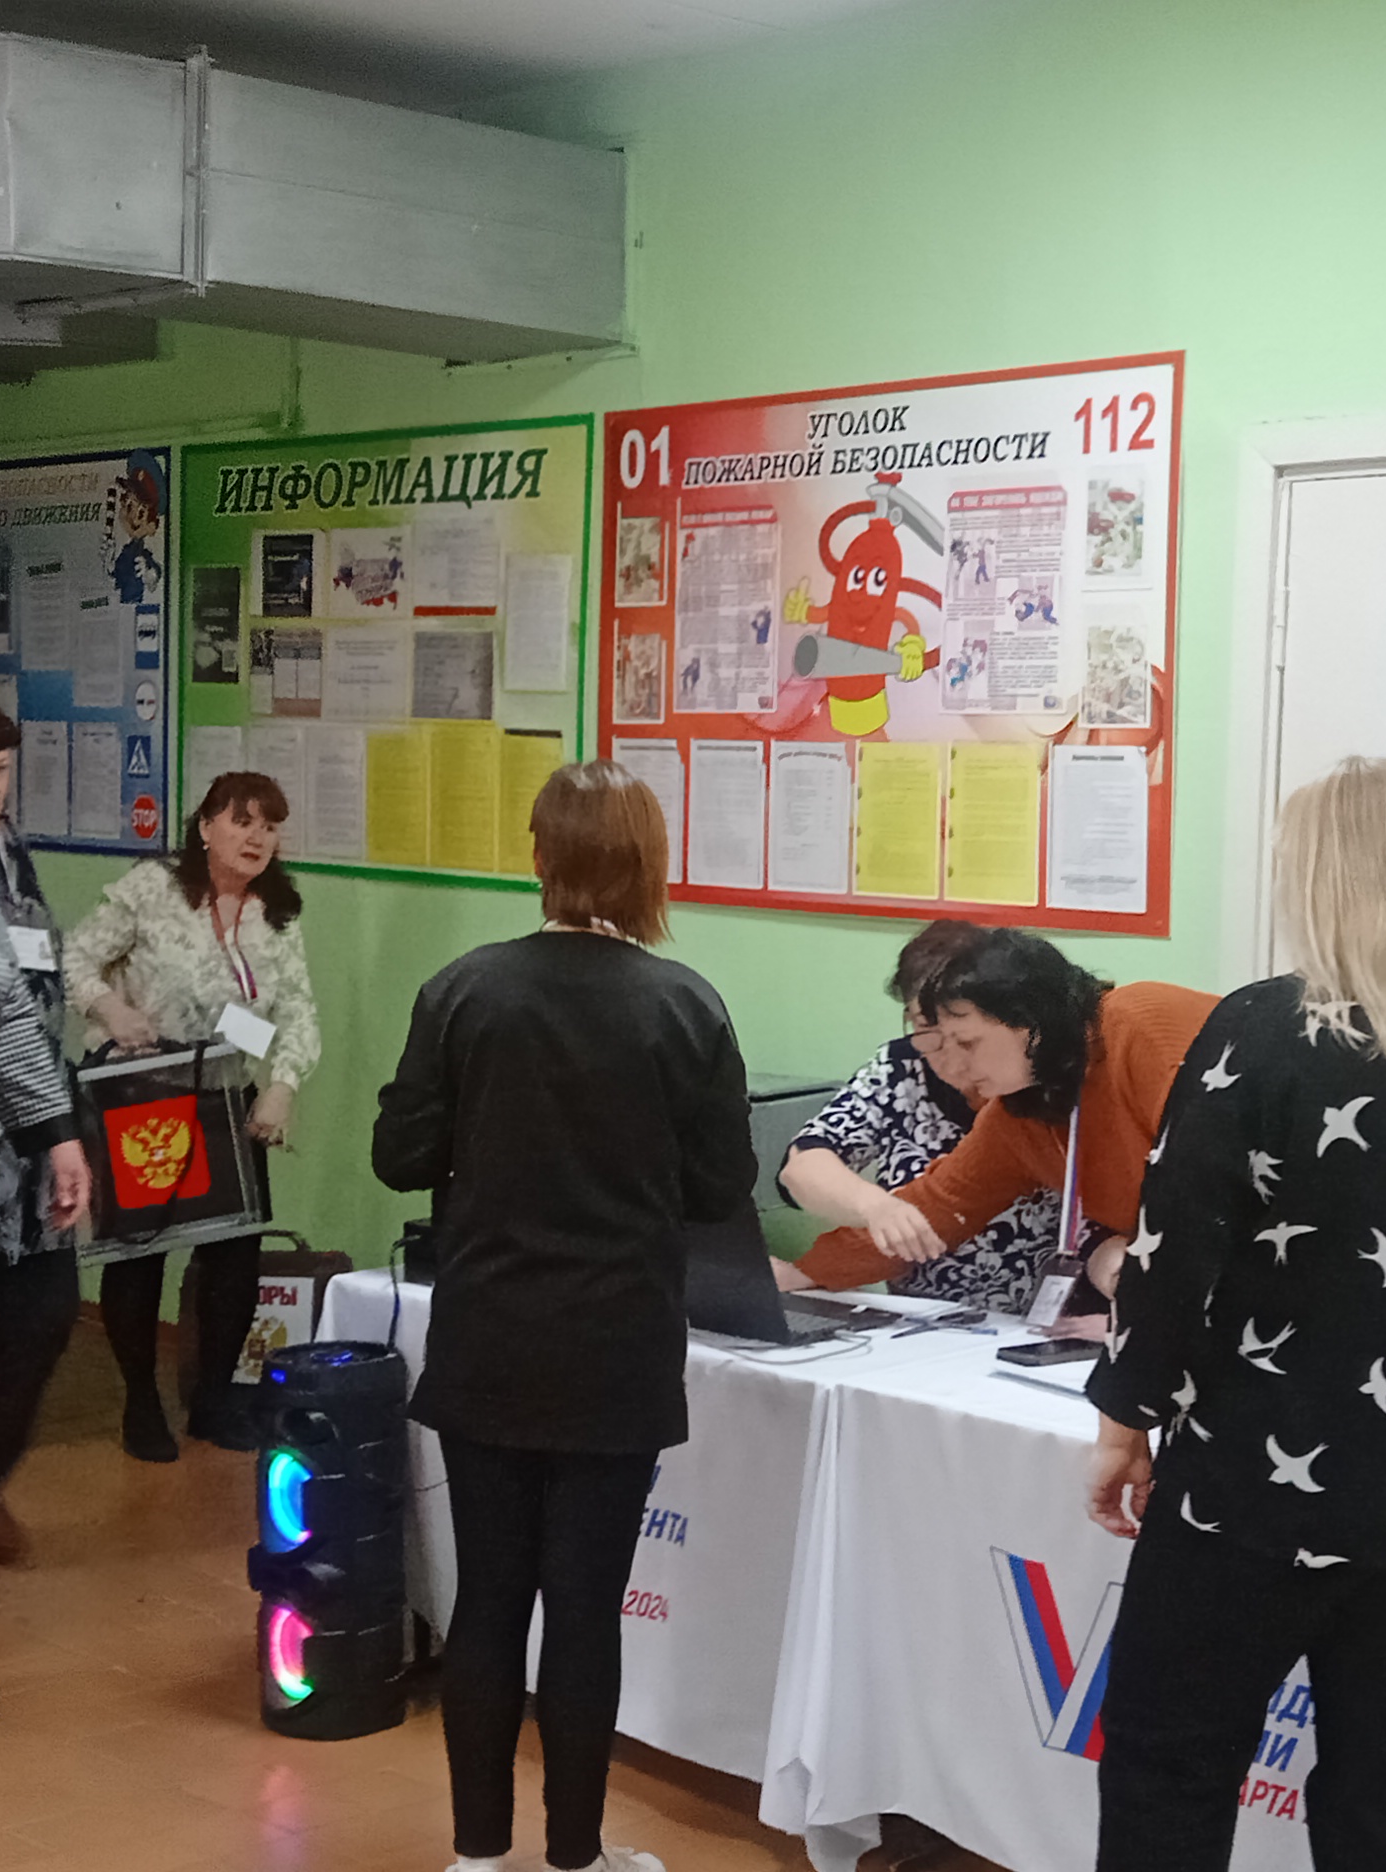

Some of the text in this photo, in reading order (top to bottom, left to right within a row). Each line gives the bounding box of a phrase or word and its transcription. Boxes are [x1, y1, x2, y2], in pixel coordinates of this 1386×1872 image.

[807, 405, 910, 440] УГОЛОК
[1073, 391, 1157, 455] 112
[619, 425, 672, 489] 01
[683, 431, 1051, 487] ПОЖАРНОЙ БЕЗОПАСНОСТИ
[215, 447, 549, 517] ИНФОРМАЦИЯ
[132, 808, 157, 828] STOP
[644, 1508, 688, 1547] НТА
[621, 1590, 669, 1622] 2024
